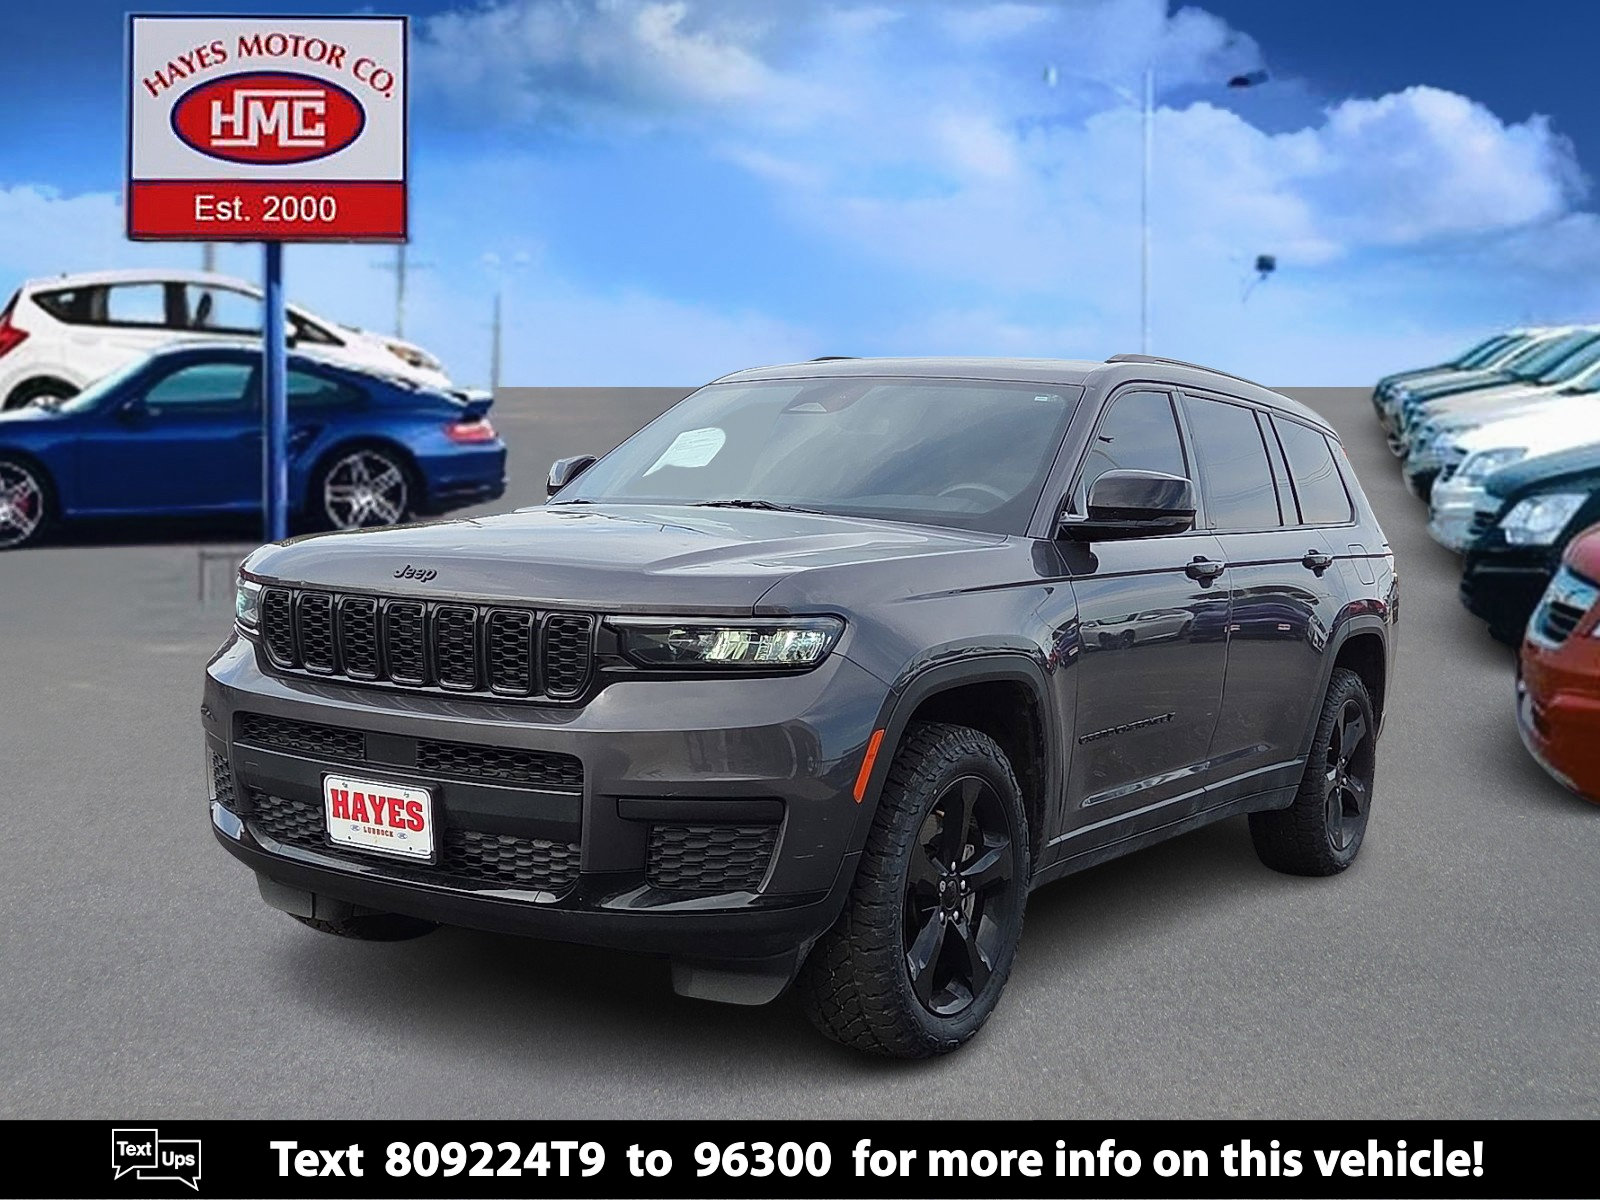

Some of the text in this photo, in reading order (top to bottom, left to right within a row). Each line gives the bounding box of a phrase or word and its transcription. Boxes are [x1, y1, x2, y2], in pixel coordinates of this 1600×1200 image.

[142, 33, 395, 99] HAYES MOTOR CO.
[210, 88, 326, 147] HMC
[194, 194, 337, 222] Est. 2000
[393, 564, 438, 584] Jeep
[330, 788, 425, 832] HAYES
